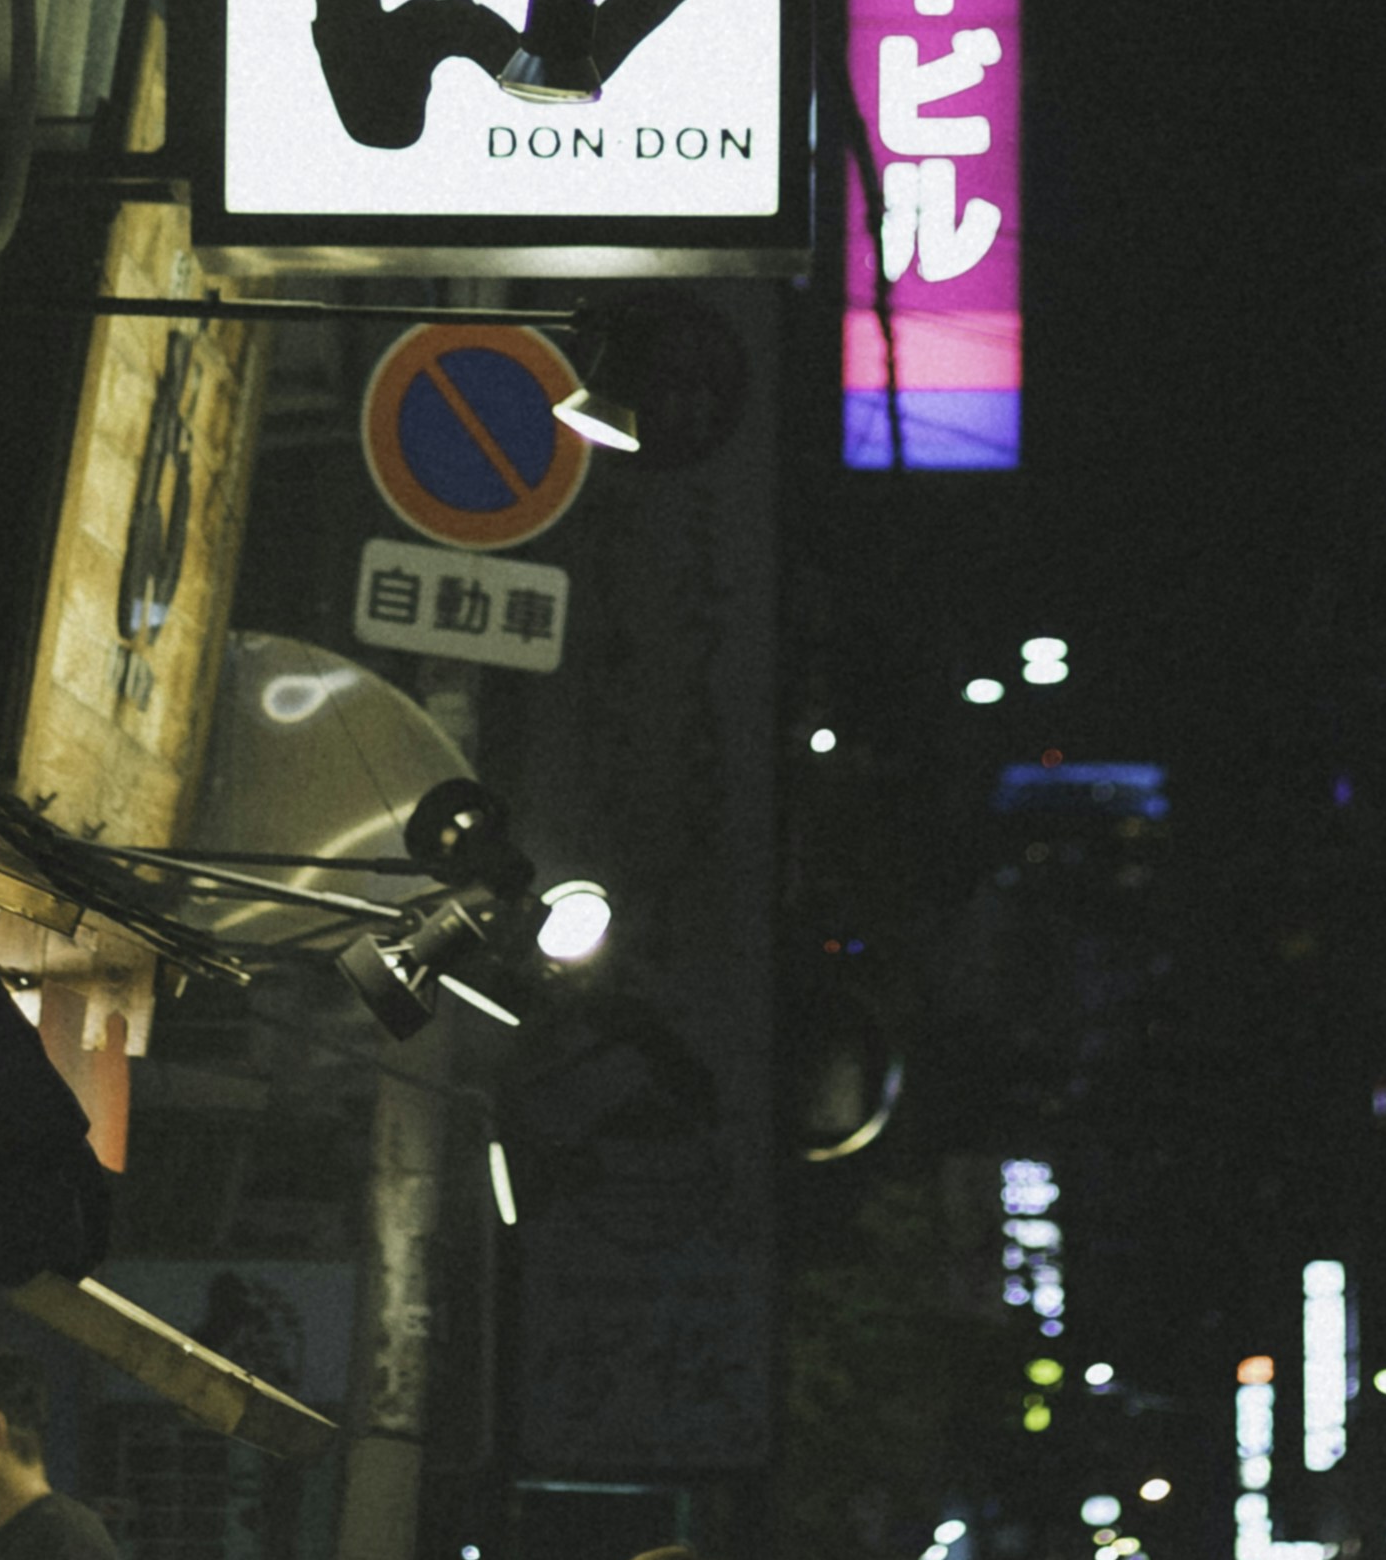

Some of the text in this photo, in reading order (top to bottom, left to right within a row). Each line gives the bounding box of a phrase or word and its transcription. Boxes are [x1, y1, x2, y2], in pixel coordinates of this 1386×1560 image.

[487, 126, 753, 160] DON DON
[367, 566, 557, 645] 自動車
